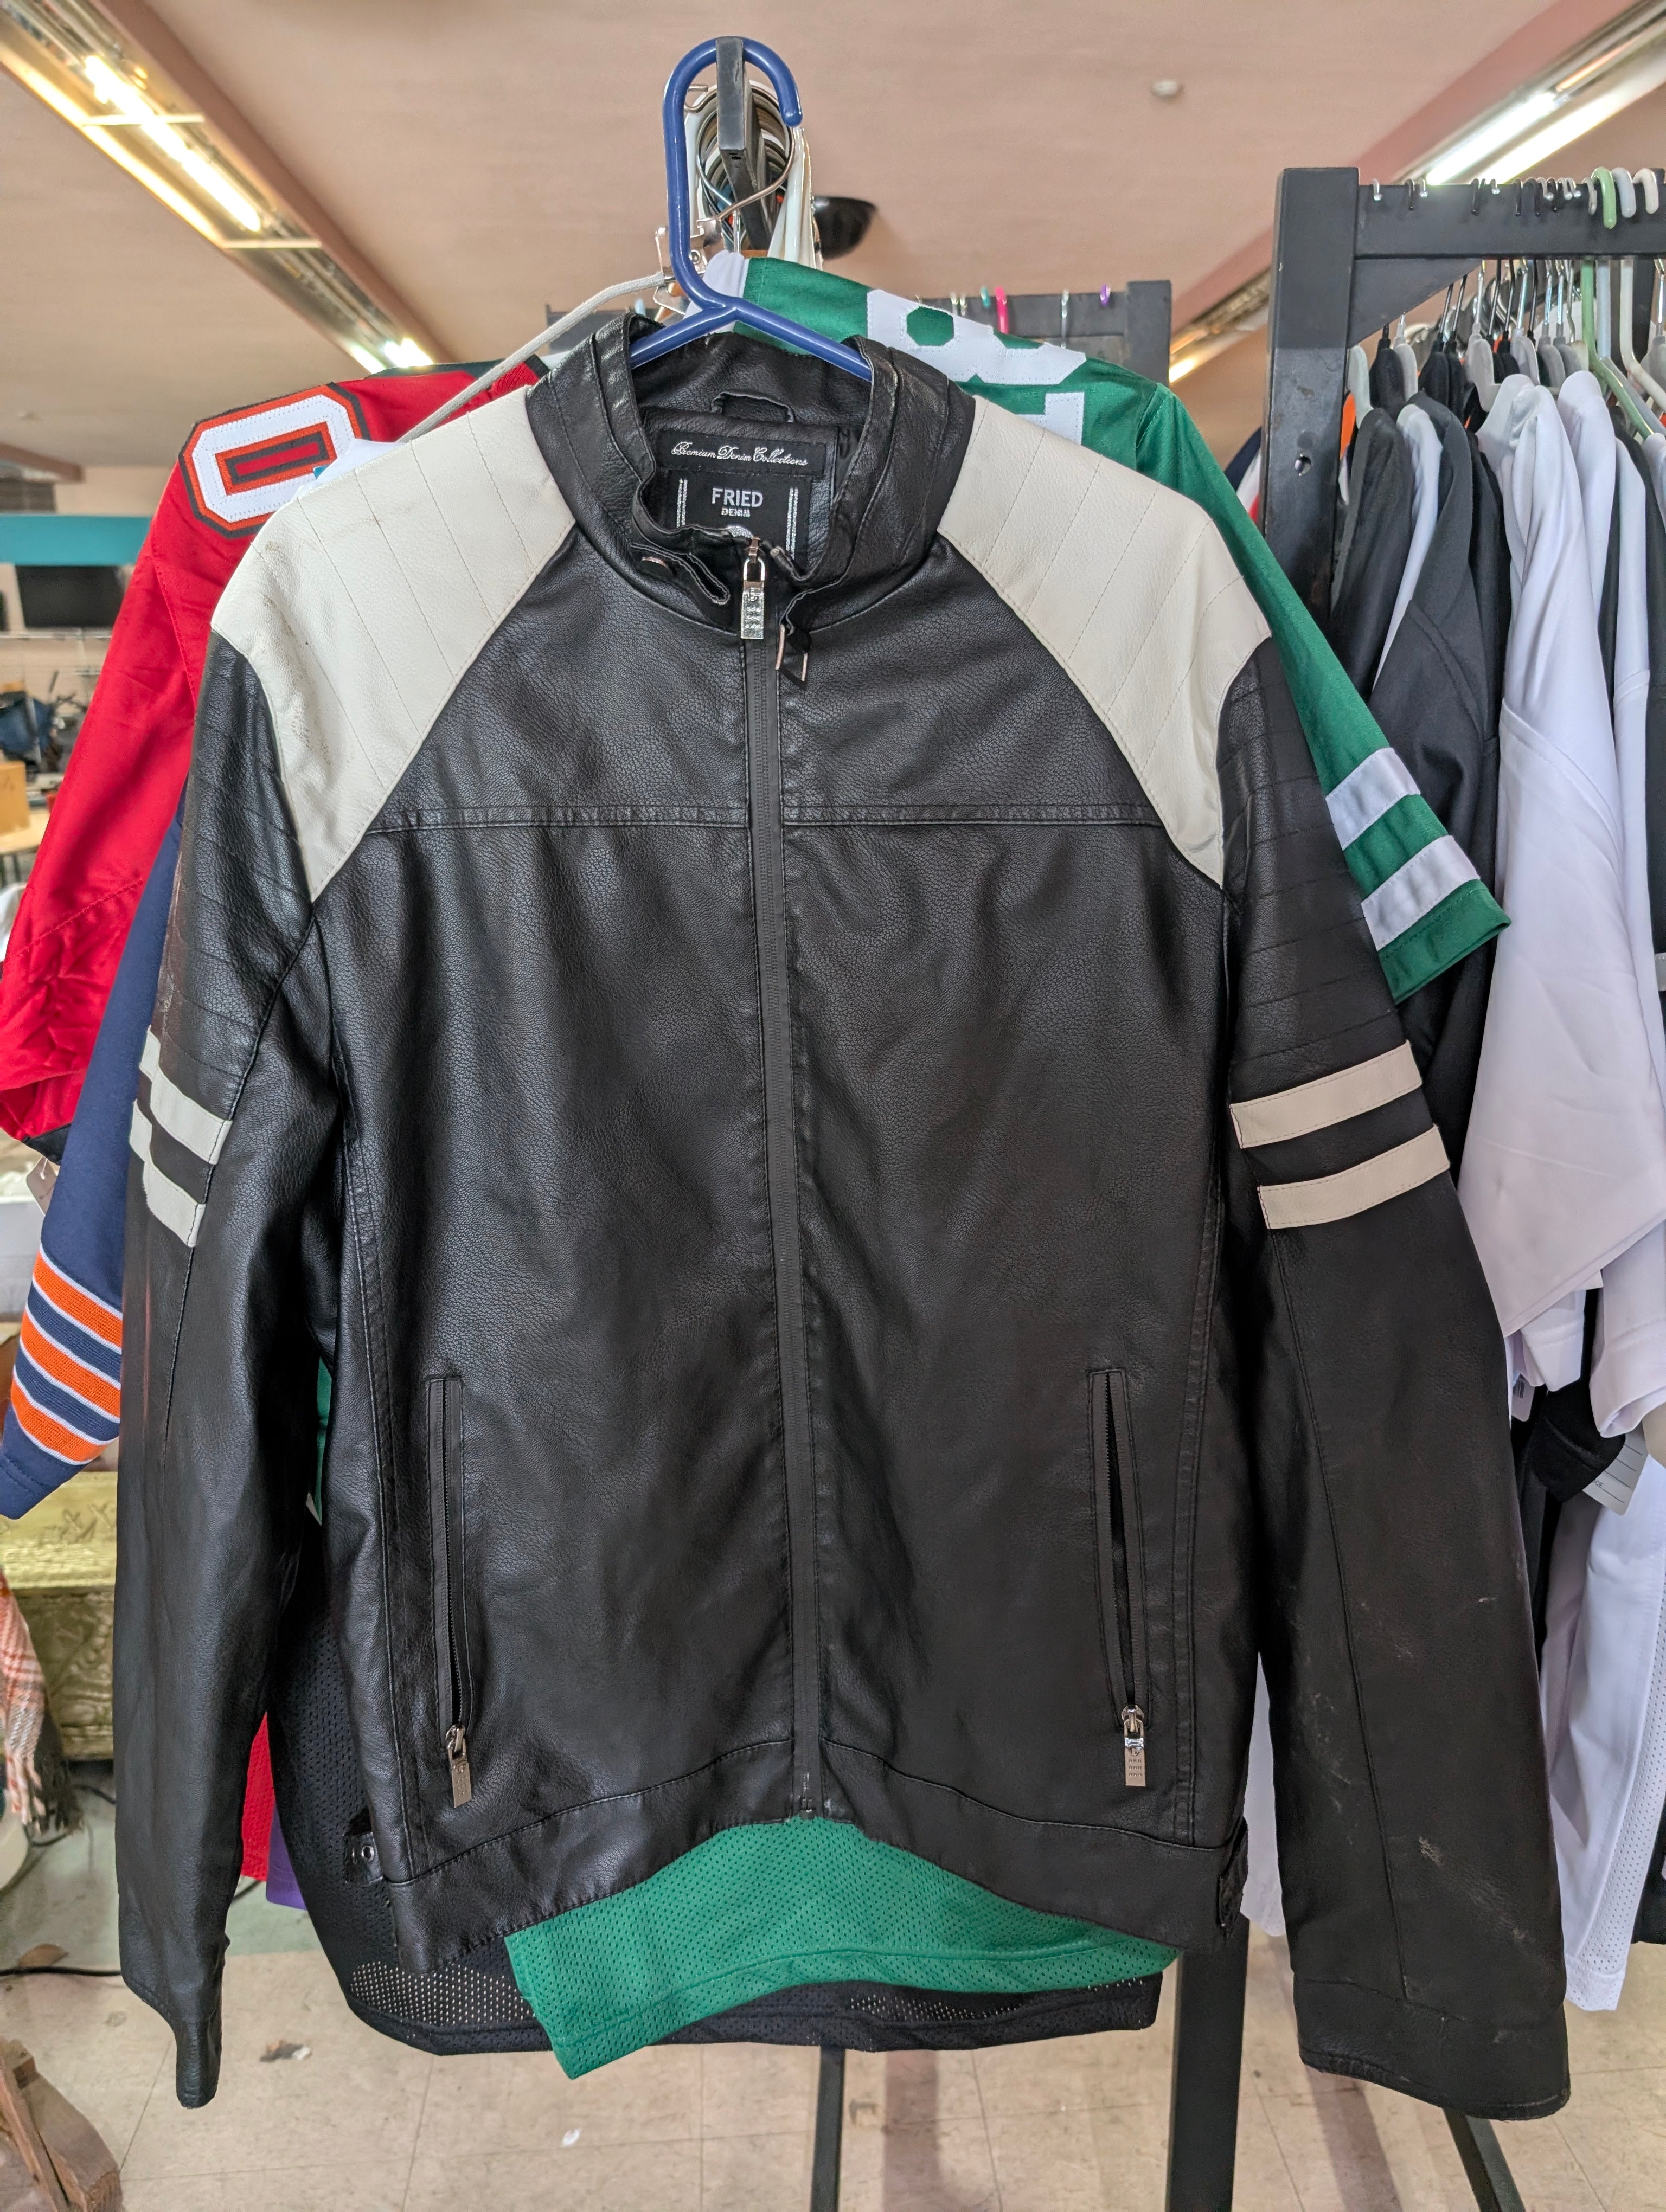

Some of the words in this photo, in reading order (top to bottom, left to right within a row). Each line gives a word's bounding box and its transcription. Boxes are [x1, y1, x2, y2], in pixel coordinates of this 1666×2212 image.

[671, 442, 716, 458] Premium
[717, 445, 752, 461] Denim
[753, 447, 808, 466] Collections
[712, 488, 764, 507] FRIED
[721, 507, 751, 517] DENIM
